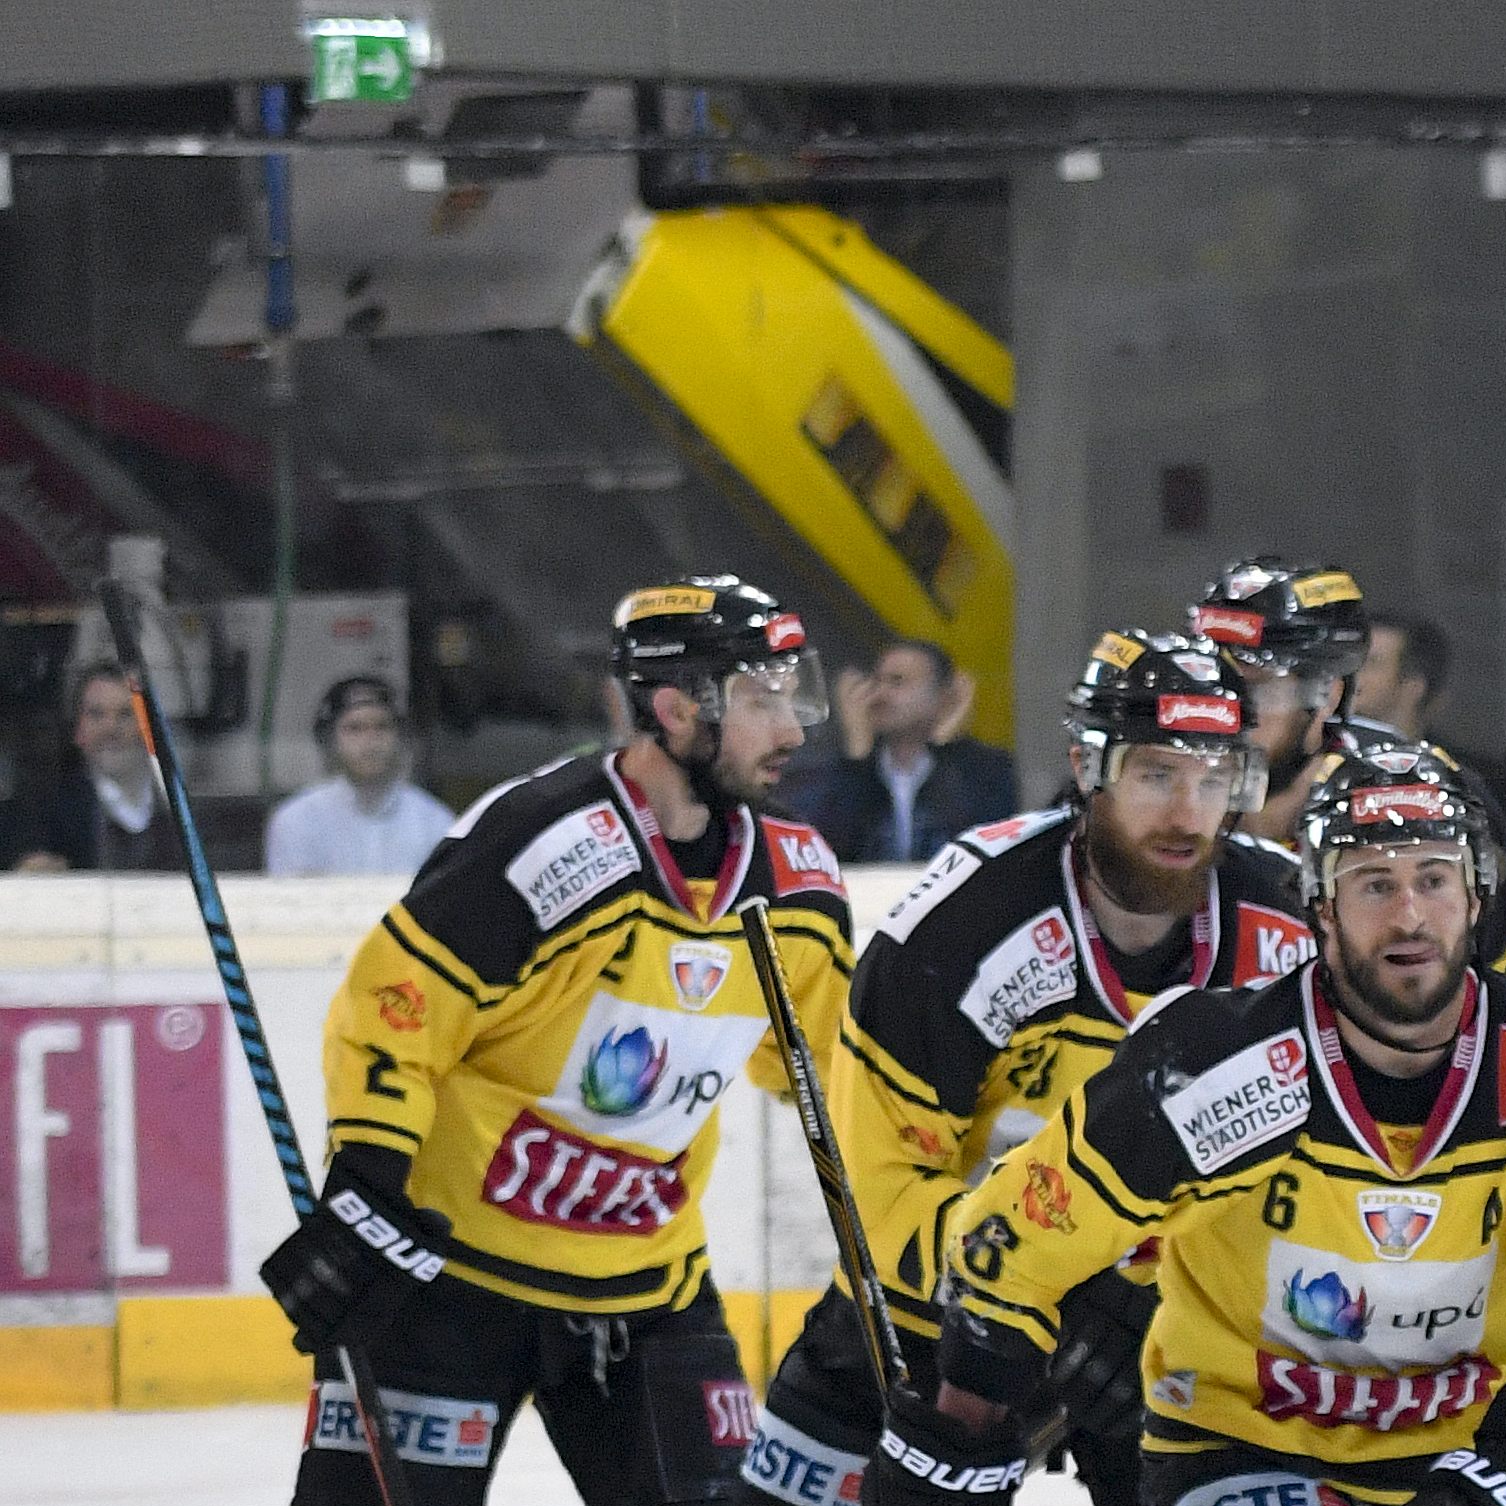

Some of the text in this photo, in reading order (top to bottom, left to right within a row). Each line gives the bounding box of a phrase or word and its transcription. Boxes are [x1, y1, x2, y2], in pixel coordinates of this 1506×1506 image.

[528, 838, 598, 897] WIENER
[366, 1042, 407, 1102] 2
[1183, 1075, 1274, 1138] WIENER
[1262, 1171, 1300, 1232] 6
[963, 1213, 1020, 1281] 6
